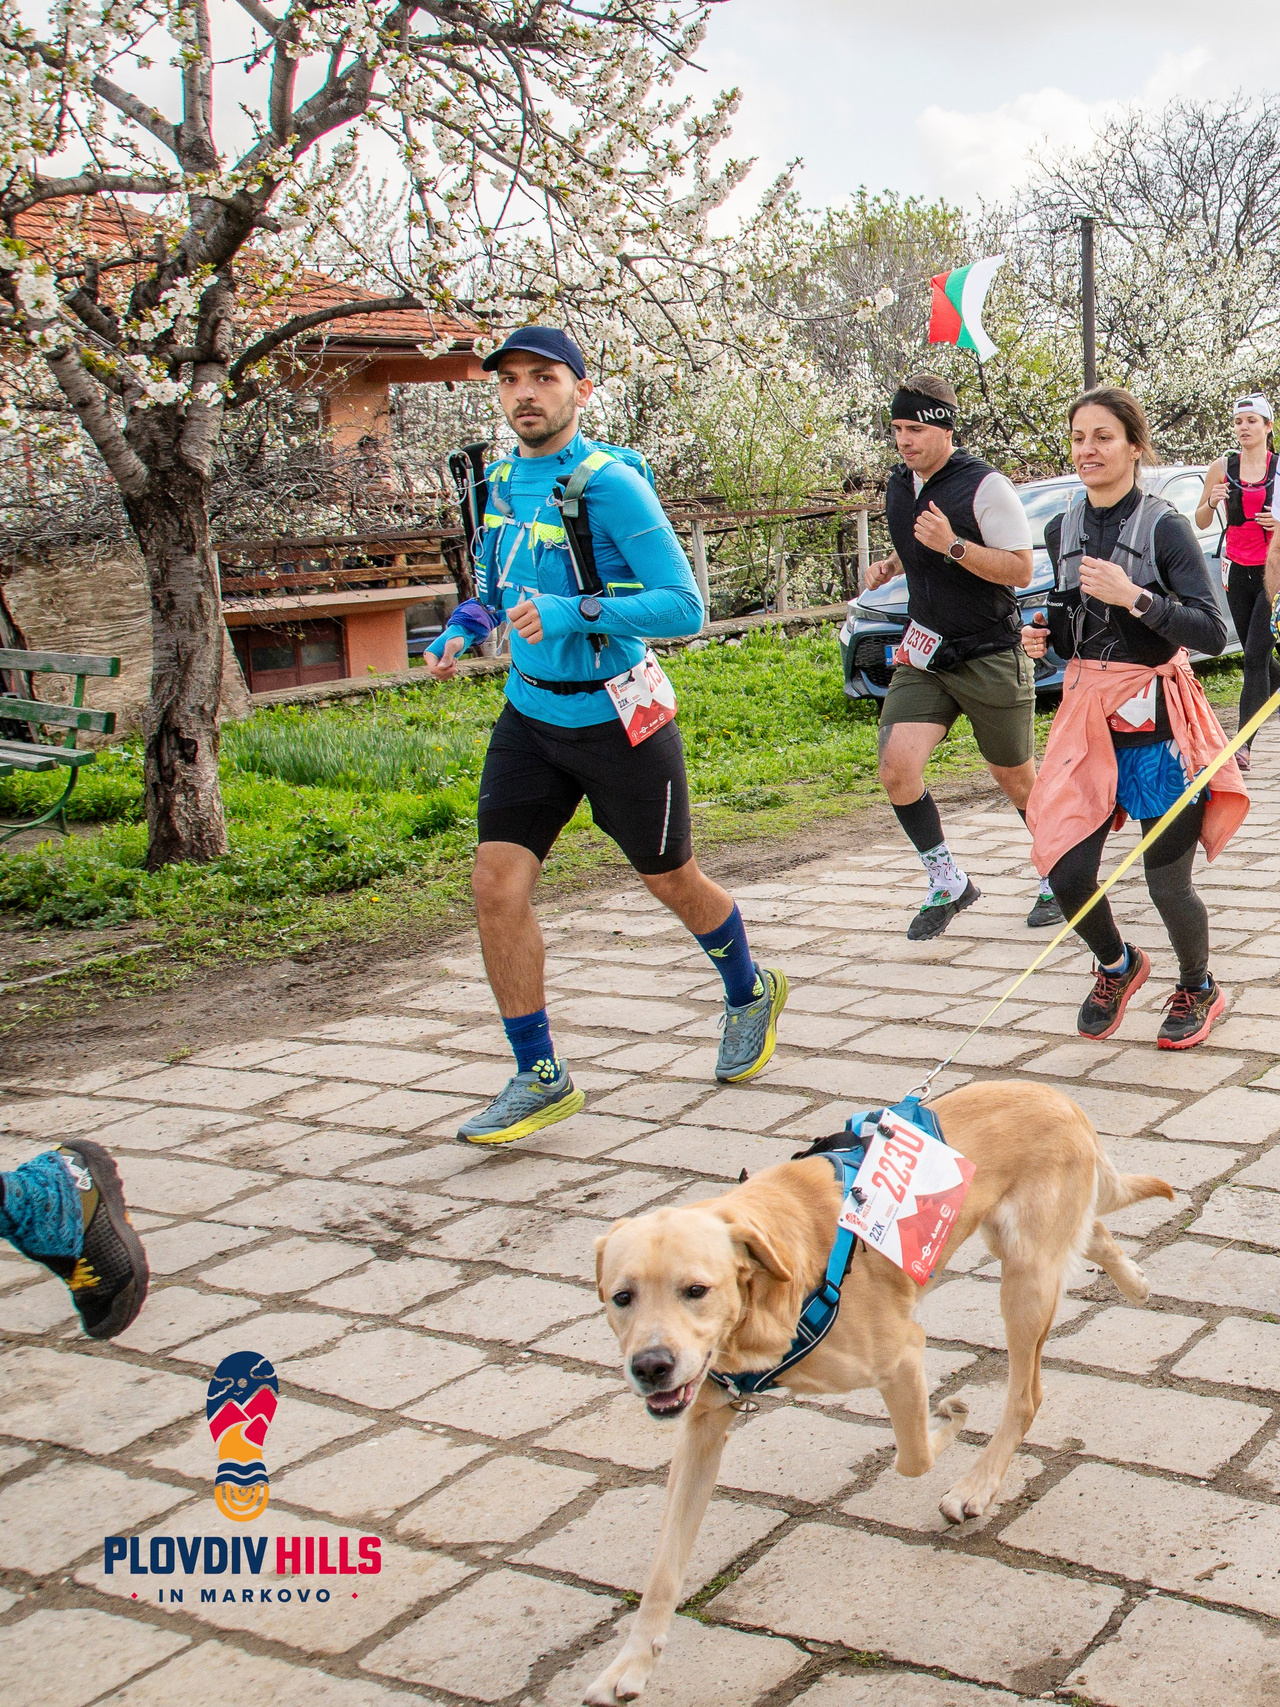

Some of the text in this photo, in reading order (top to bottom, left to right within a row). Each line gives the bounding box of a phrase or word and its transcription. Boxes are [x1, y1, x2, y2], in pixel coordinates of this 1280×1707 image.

[906, 627, 937, 655] 2376
[617, 696, 629, 709] 22K
[871, 1123, 925, 1204] 2230
[869, 1221, 886, 1243] 22K
